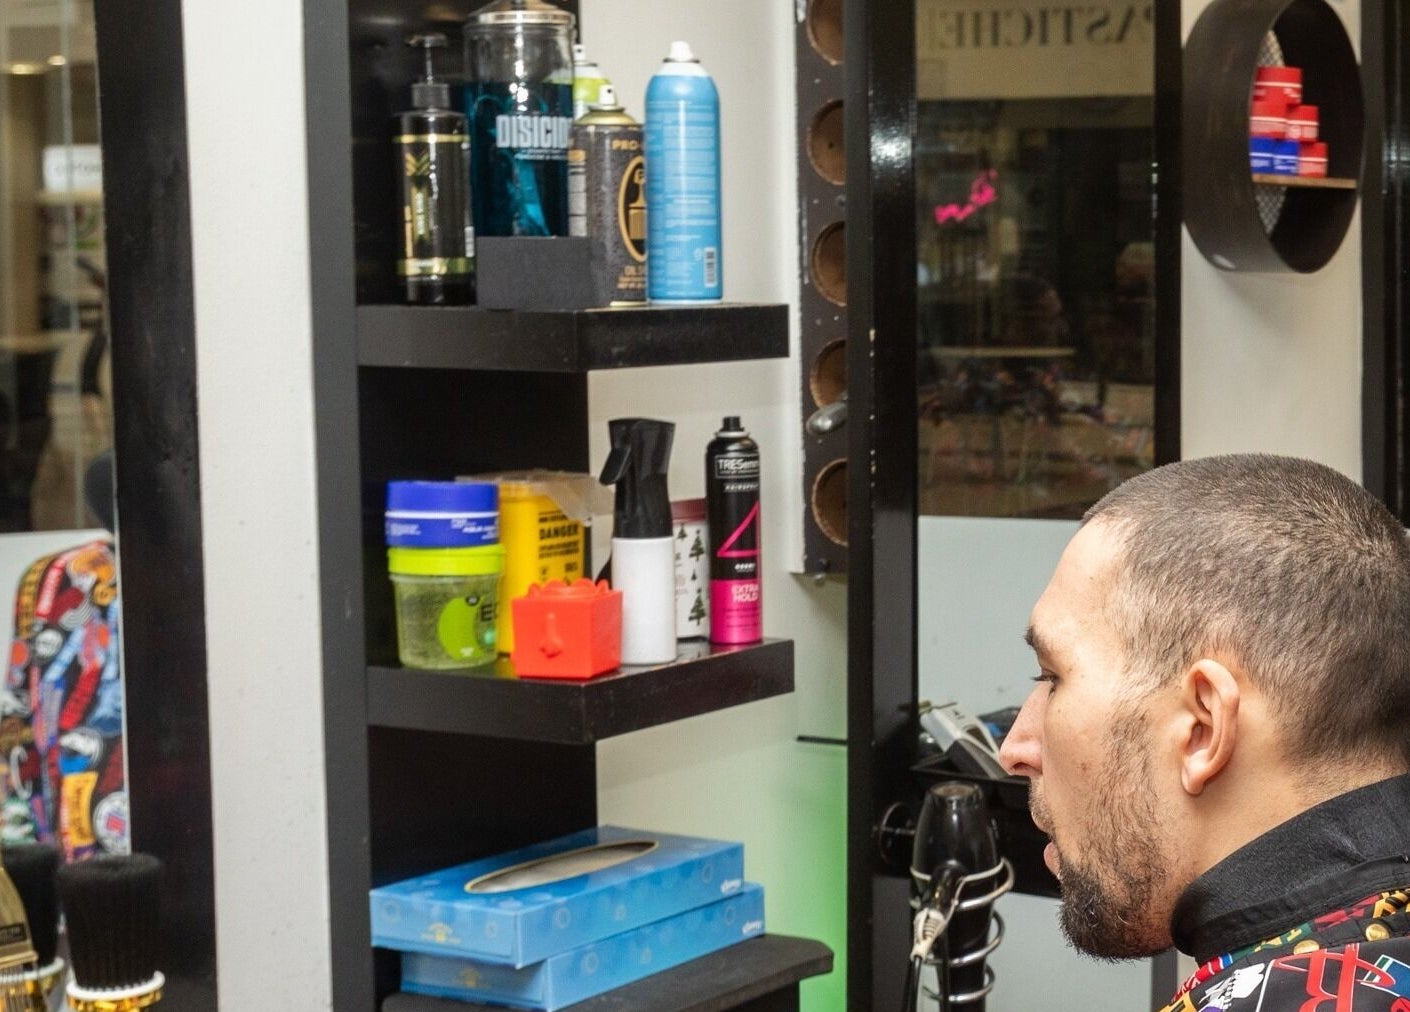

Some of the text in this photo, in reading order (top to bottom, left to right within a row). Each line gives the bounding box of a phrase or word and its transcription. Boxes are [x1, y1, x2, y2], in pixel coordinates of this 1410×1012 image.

[496, 114, 573, 149] DISICID
[539, 522, 579, 540] DANGER
[733, 592, 759, 602] HOLD
